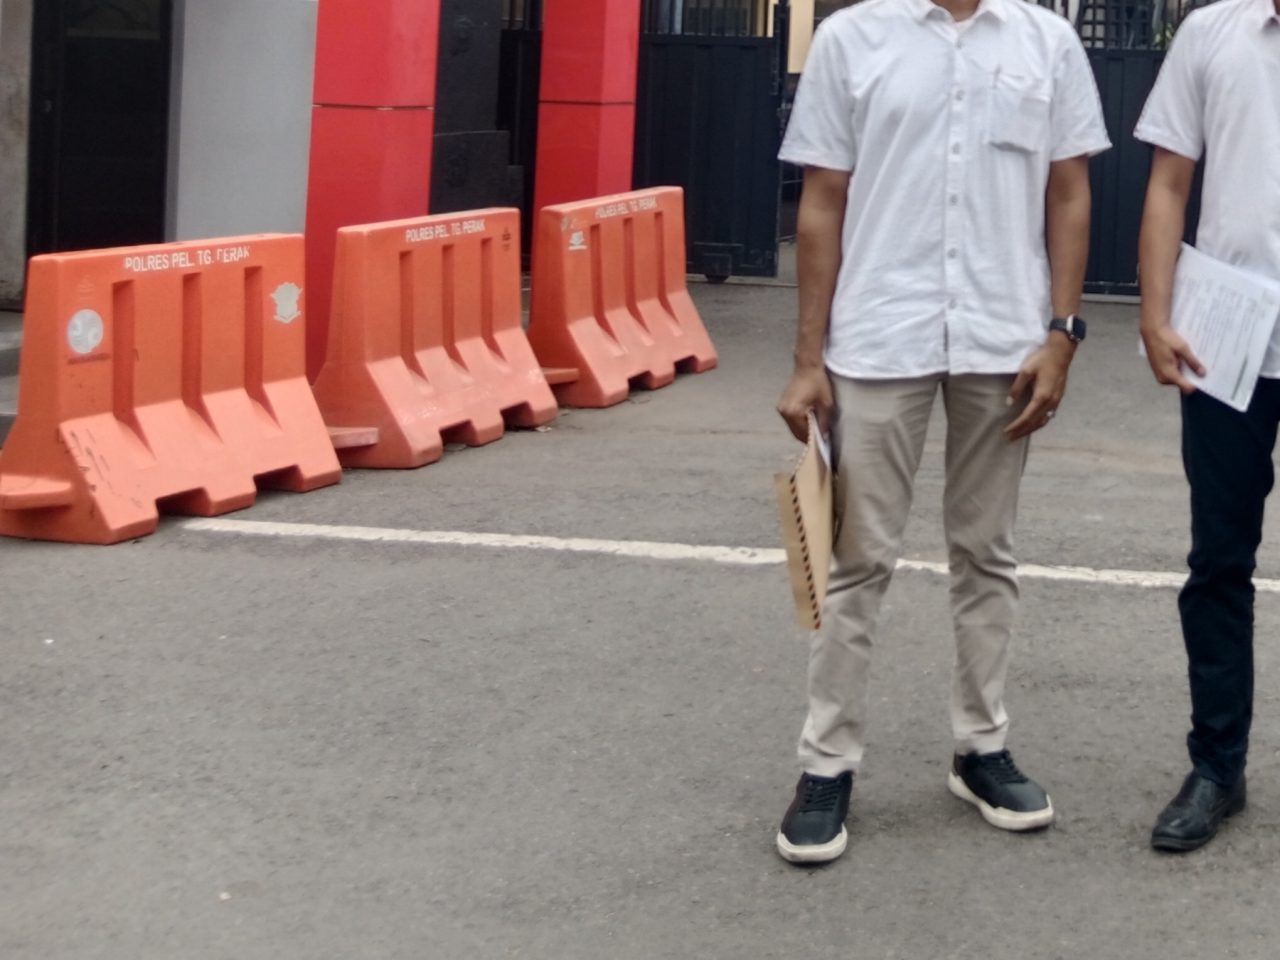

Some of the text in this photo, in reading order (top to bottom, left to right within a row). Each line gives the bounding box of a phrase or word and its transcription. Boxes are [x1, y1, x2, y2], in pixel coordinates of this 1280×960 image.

[405, 226, 434, 243] POLRES
[462, 218, 486, 234] PERAK
[124, 253, 169, 272] POLRES
